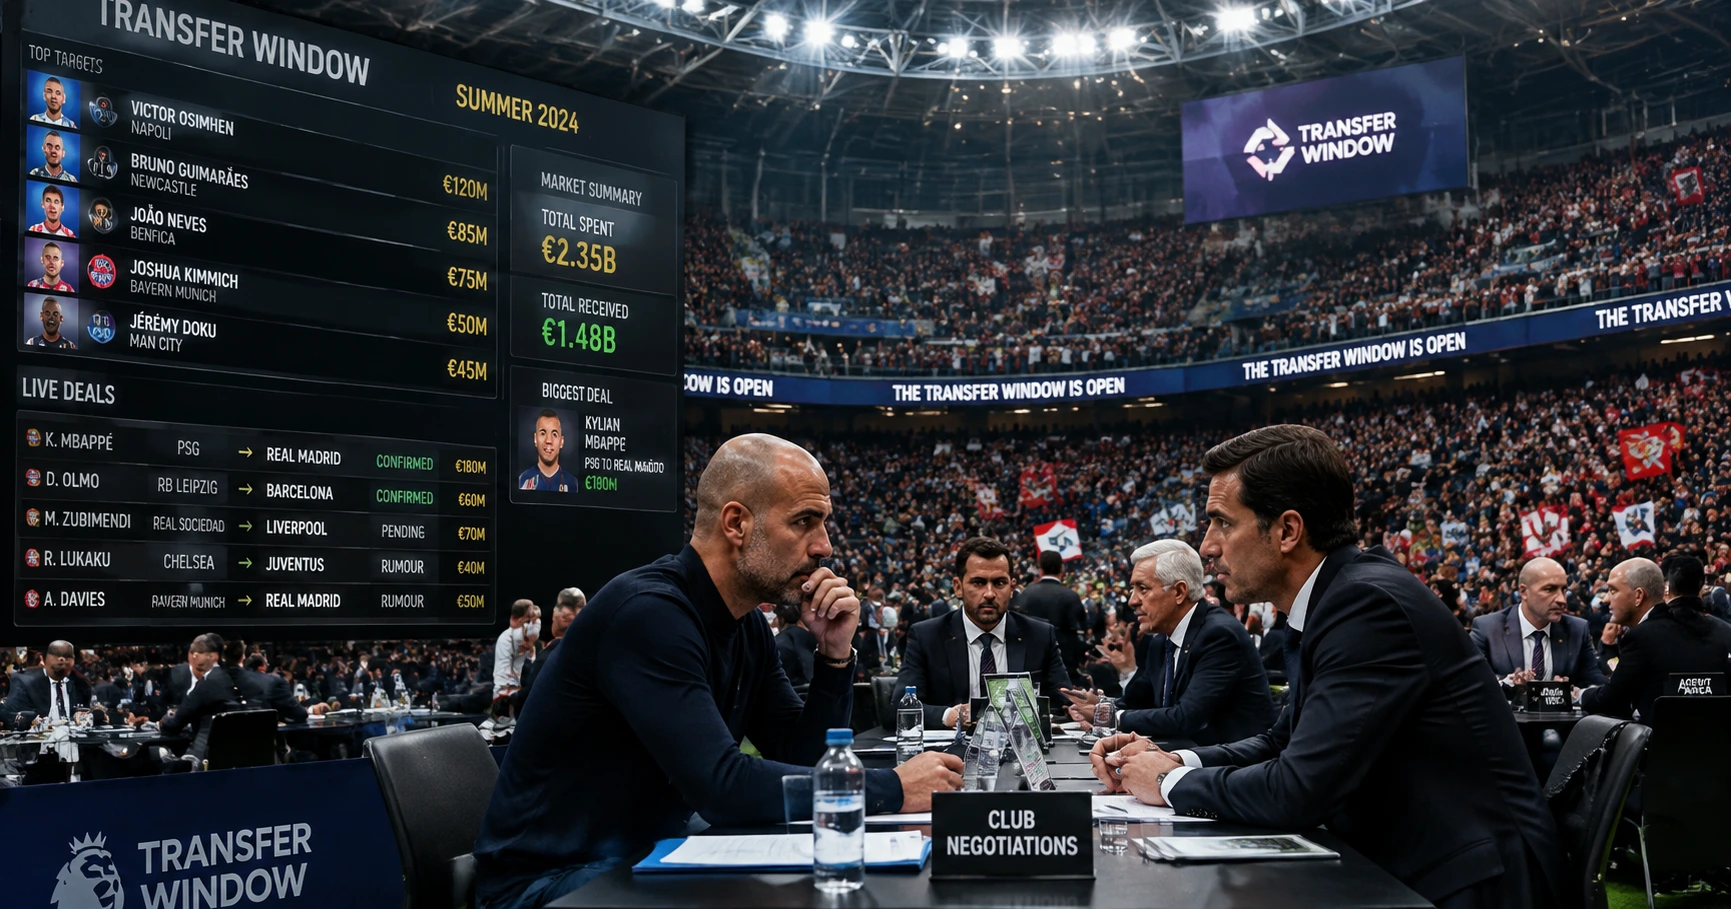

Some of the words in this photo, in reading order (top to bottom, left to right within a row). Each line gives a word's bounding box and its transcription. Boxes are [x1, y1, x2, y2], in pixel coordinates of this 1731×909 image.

[101, 0, 244, 58] TRANSFER
[252, 30, 370, 86] WINDOW
[29, 44, 51, 62] TOP
[55, 50, 103, 74] TARGETS
[131, 100, 176, 124] VICTOR
[180, 110, 234, 136] OSIMHEN
[456, 84, 532, 123] SUMMER
[537, 103, 579, 134] 2024
[131, 120, 171, 141] NAPOLI
[1298, 111, 1396, 142] TRANSFER
[1301, 132, 1395, 164] WINDOW
[131, 152, 175, 175] BRUNO
[131, 173, 197, 197] NEWCASTLE
[443, 174, 488, 201] €120M
[541, 171, 586, 196] MARKET
[589, 182, 642, 206] SUMMARY
[167, 212, 207, 233] NEVES
[541, 208, 576, 230] TOTAL
[579, 216, 614, 237] SPENT
[130, 225, 176, 245] BENFICA
[447, 222, 487, 246] €85M
[542, 235, 616, 274] €2.35B
[130, 259, 181, 281] JOSHUA
[184, 266, 238, 289] KIMMICH
[447, 266, 487, 291] €75M
[130, 279, 172, 298] BAYERN
[175, 285, 217, 303] MUNICH
[542, 292, 575, 312] TOTAL
[578, 297, 629, 320] RECEIVED
[1595, 306, 1628, 329] THE
[1632, 291, 1722, 324] TRANSFER
[182, 319, 216, 338] DOKU
[447, 312, 487, 336] €50M
[130, 333, 155, 349] MAN
[159, 336, 183, 352] CITY
[542, 318, 616, 354] €1.48B
[1243, 360, 1268, 380] THE
[1271, 350, 1341, 377] TRANSFER
[1343, 340, 1406, 366] WINDOW
[1409, 337, 1423, 357] IS
[1426, 332, 1466, 354] OPEN
[447, 358, 487, 381] €45M
[22, 377, 58, 399] LIVE
[64, 381, 115, 404] DEALS
[542, 382, 584, 401] BIGGEST
[587, 387, 613, 404] DEAL
[717, 376, 730, 394] IS
[733, 377, 773, 397] OPEN
[892, 384, 921, 401] THE
[924, 383, 998, 401] TRANSFER
[1001, 380, 1066, 400] WINDOW
[1069, 379, 1083, 397] IS
[1086, 377, 1125, 395] OPEN
[585, 415, 620, 432] KYLIAN
[45, 432, 57, 448] K.
[61, 433, 113, 450] MBAPPÉ
[177, 439, 200, 456] PSG
[585, 434, 626, 451] MBAPPE
[266, 446, 295, 463] REAL
[298, 449, 341, 465] MADRID
[376, 454, 433, 471] CONFIRMED
[601, 458, 612, 470] TO
[613, 459, 633, 472] REAL
[455, 458, 486, 474] €180M
[46, 471, 58, 487] D.
[63, 472, 99, 488] OLMO
[158, 477, 173, 492] RB
[177, 478, 218, 495] LEIPZIG
[266, 483, 333, 500] BARCELONA
[376, 489, 433, 505] CONFIRMED
[458, 492, 485, 507] €60M
[45, 510, 59, 526] M.
[62, 511, 131, 529] ZUBIMENDI
[153, 516, 177, 530] REAL
[179, 517, 225, 532] SOCIEDAD
[266, 519, 327, 536] LIVERPOOL
[381, 524, 425, 539] PENDING
[458, 526, 485, 541] €70M
[44, 550, 56, 566] R.
[60, 551, 110, 567] LUKAKU
[163, 554, 214, 570] CHELSEA
[266, 557, 324, 572] JUVENTUS
[381, 559, 424, 574] RUMOUR
[457, 561, 485, 575] €40M
[44, 591, 56, 607] A.
[61, 591, 105, 607] DAVIES
[265, 593, 295, 608] REAL
[297, 593, 341, 608] MADRID
[381, 594, 424, 608] RUMOUR
[456, 594, 484, 608] €50M
[988, 809, 1035, 829] CLUB
[138, 822, 312, 874] TRANSFER
[947, 836, 1078, 856] NEGOTIATIONS
[140, 862, 308, 909] WINDOW
